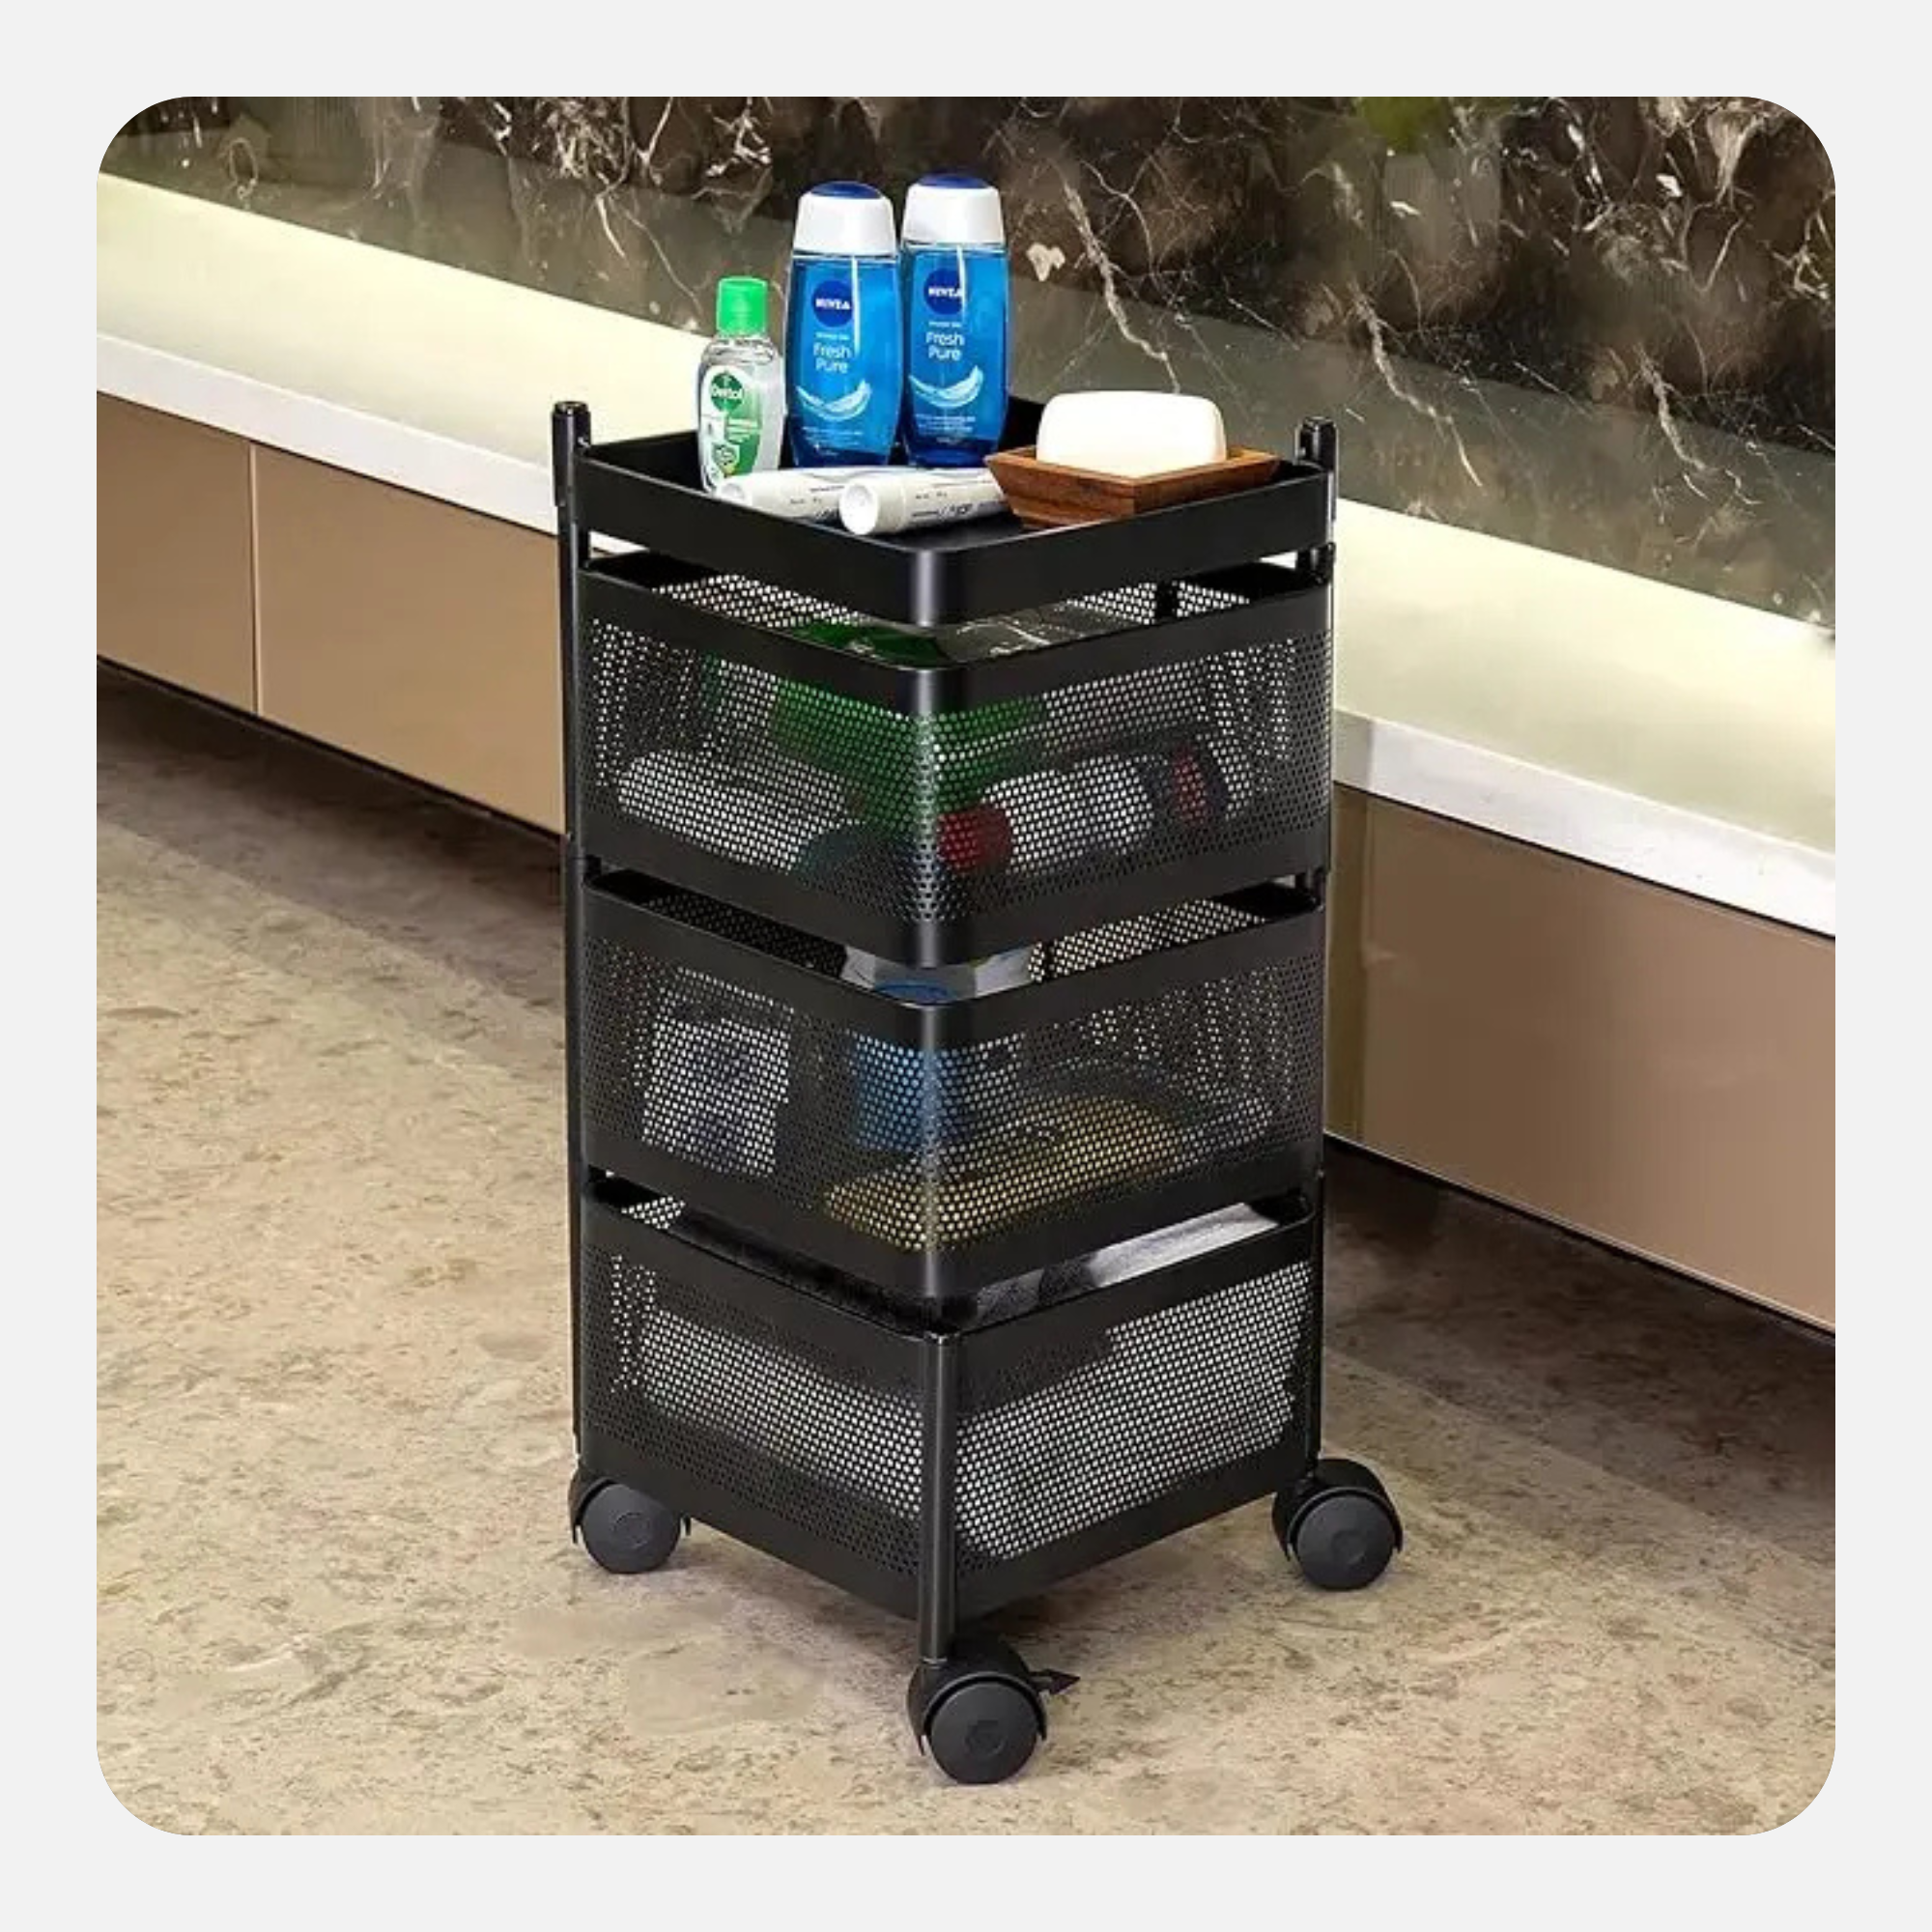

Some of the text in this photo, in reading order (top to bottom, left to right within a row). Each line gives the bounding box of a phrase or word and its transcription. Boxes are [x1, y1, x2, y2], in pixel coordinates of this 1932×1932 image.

[925, 331, 965, 346] Fresh
[813, 342, 851, 358] Fresh
[928, 345, 961, 361] Pure
[815, 357, 848, 373] Pure
